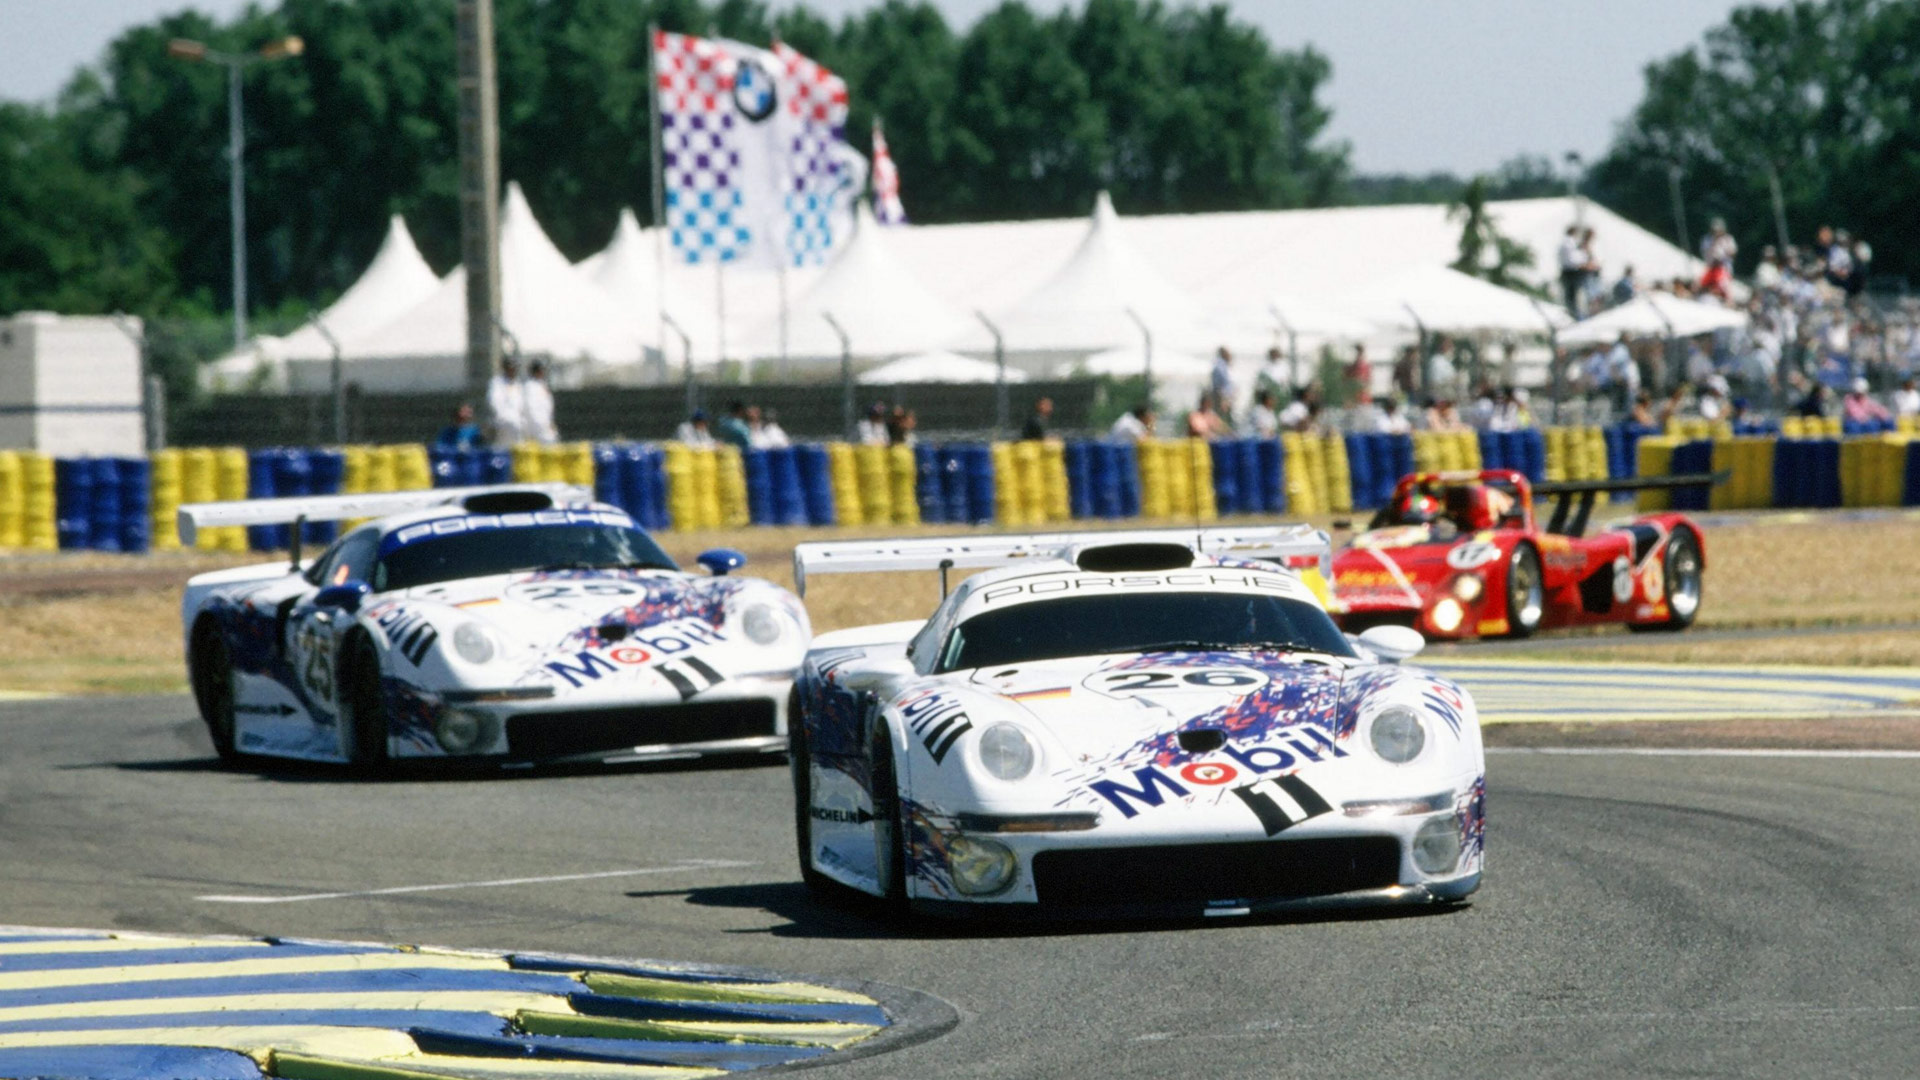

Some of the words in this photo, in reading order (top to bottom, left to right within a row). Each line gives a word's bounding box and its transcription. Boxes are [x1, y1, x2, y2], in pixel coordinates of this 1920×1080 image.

[397, 511, 634, 544] PORSCHE
[984, 574, 1293, 604] PORSCHE
[546, 622, 728, 689] Mobil
[1105, 671, 1258, 692] 26
[1087, 727, 1350, 820] Mobil
